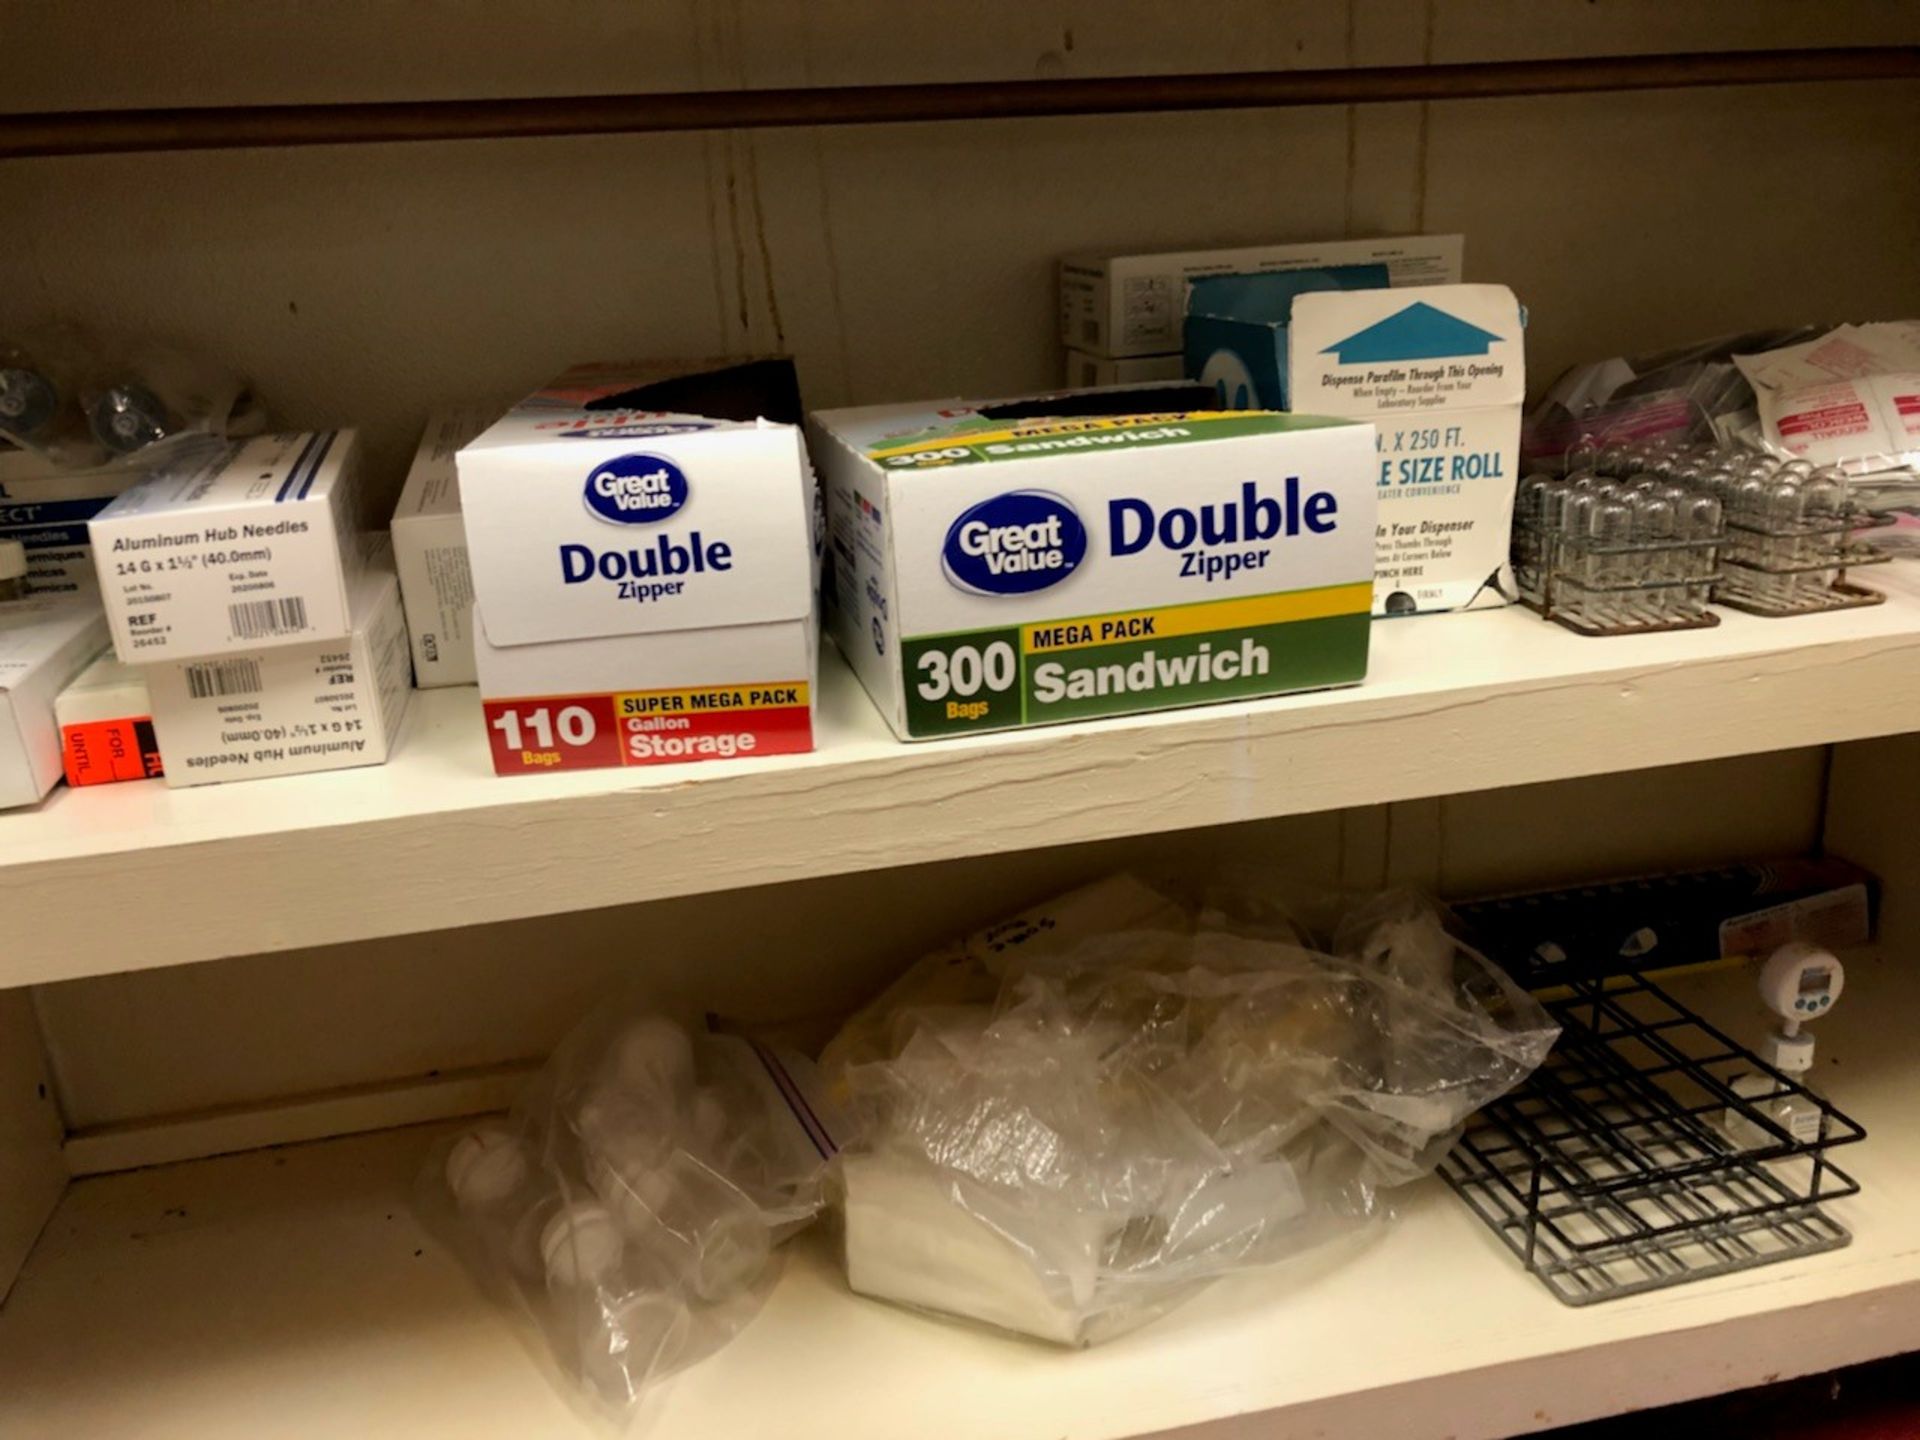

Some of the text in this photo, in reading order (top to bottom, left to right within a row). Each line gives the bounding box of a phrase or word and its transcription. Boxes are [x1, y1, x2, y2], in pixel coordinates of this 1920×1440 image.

[1322, 363, 1503, 388] Dispense Parafilm Through This Opening
[1353, 386, 1373, 398] When
[1375, 384, 1397, 399] Empty
[1407, 382, 1434, 395] Reorder
[1437, 382, 1454, 393] From
[1456, 380, 1472, 391] Your
[1377, 395, 1446, 409] Laboratory Supplier
[1012, 419, 1100, 439] MEGA
[1394, 431, 1404, 451] X
[1410, 428, 1440, 451] 250
[1445, 426, 1466, 447] FT.
[985, 426, 1191, 456] Sandwich
[888, 446, 971, 466] 300
[1400, 456, 1445, 485] SIZE
[1451, 451, 1503, 480] ROLL
[595, 468, 670, 496] Great
[614, 492, 672, 511] Value
[1108, 477, 1338, 557] Double
[113, 521, 309, 552] Aluminum Hub Needles
[959, 515, 1062, 557] Great
[1391, 523, 1416, 537] Your
[1420, 520, 1475, 537] Dispenser
[1424, 536, 1452, 549] Through
[117, 562, 137, 576] 14
[140, 560, 152, 573] G
[155, 561, 164, 570] x
[201, 547, 272, 568] (40.0mm)
[559, 531, 732, 584] Double
[984, 547, 1064, 576] Value
[1180, 548, 1271, 580] Zipper
[1402, 552, 1428, 562] Corners
[1431, 550, 1452, 560] Below
[229, 569, 268, 582] Exp. Date
[1402, 566, 1424, 577] HERE
[123, 584, 153, 593] Lot No.
[618, 580, 685, 602] Zipper
[128, 614, 157, 626] REF
[130, 627, 164, 637] Reorder
[1033, 615, 1155, 649] MEGA PACK
[329, 673, 354, 685] REF
[917, 640, 1016, 701] 300
[1033, 637, 1270, 704] Sandwich
[624, 688, 798, 713] SUPER MEGA PACK
[946, 699, 989, 720] Bags
[221, 725, 287, 744] (40.0mm)
[321, 723, 328, 731] x
[331, 721, 342, 733] G
[345, 719, 363, 732] 14
[494, 706, 596, 750] 110
[627, 715, 690, 732] Gallon
[70, 732, 91, 774] UNTIL
[107, 728, 125, 759] FOR
[186, 738, 366, 770] Aluminum Hub Needles
[629, 731, 757, 759] Storage
[522, 750, 561, 766] Bags
